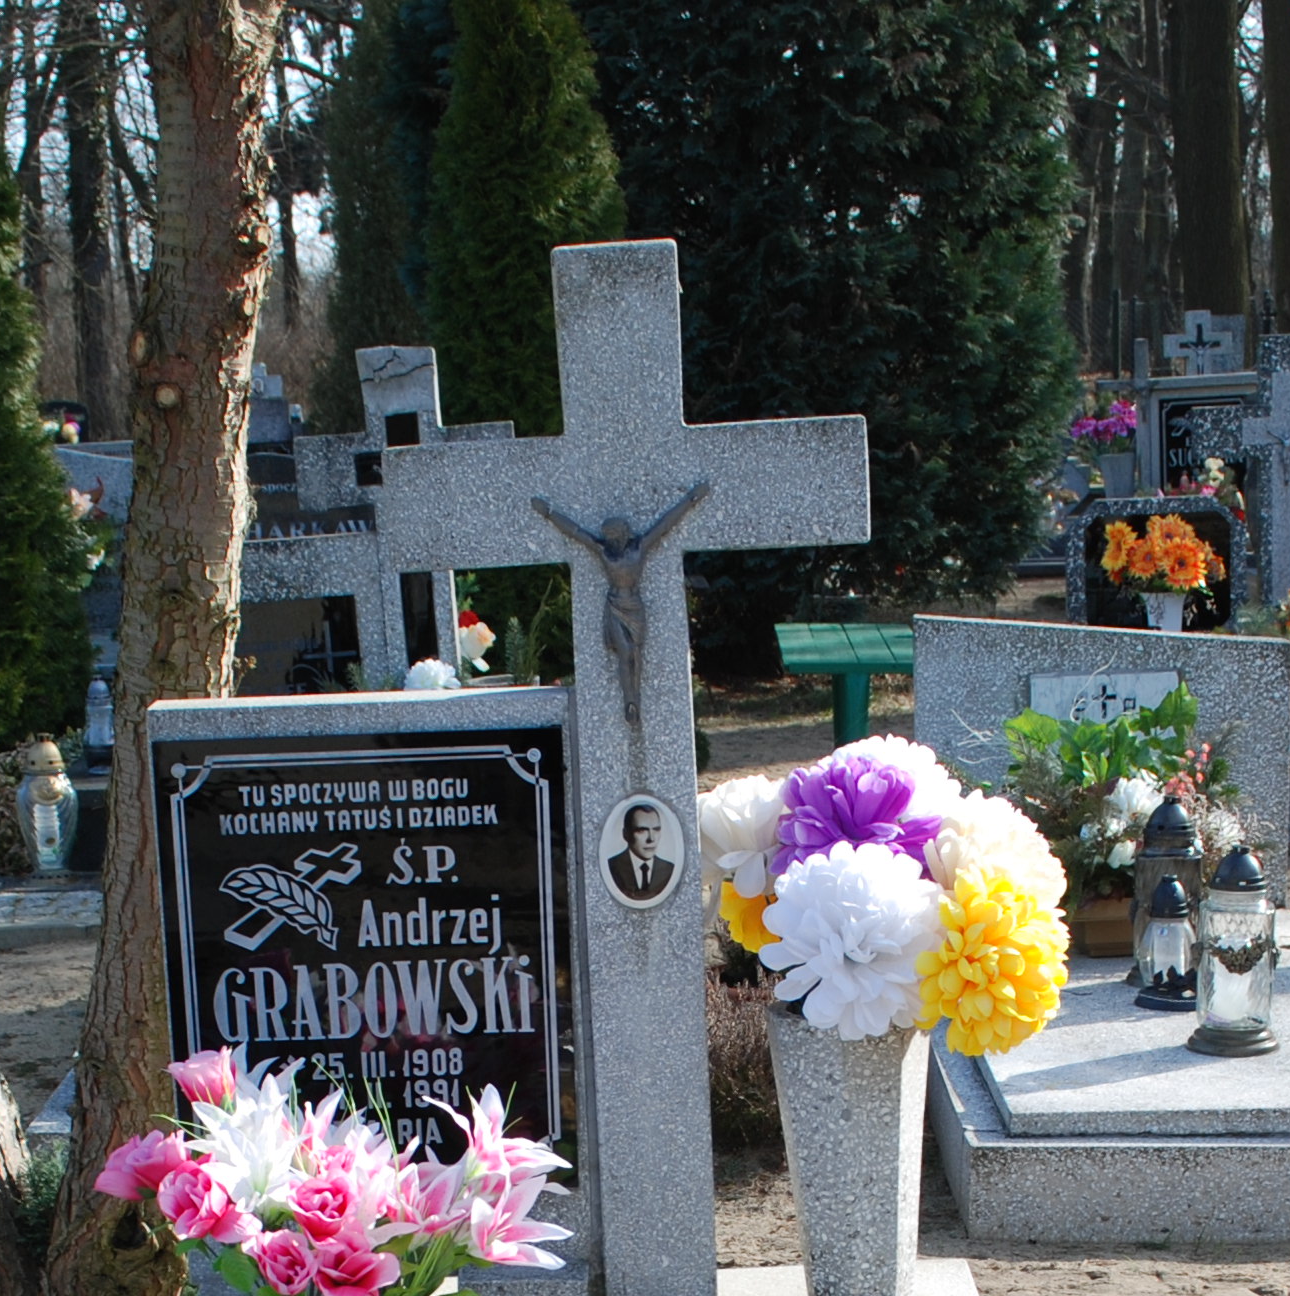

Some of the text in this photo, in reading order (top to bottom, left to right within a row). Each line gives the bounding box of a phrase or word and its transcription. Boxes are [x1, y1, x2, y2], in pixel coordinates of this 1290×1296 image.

[238, 778, 469, 807] TU SPOCZYWA W BOGU
[219, 804, 499, 836] KOCHANY TATUŚ I DZIADEK
[385, 837, 459, 886] Ś.P.
[358, 893, 503, 956] Andrzej
[401, 1046, 464, 1078] 1908
[402, 1078, 460, 1109] 1991
[396, 1116, 444, 1146] RIA
